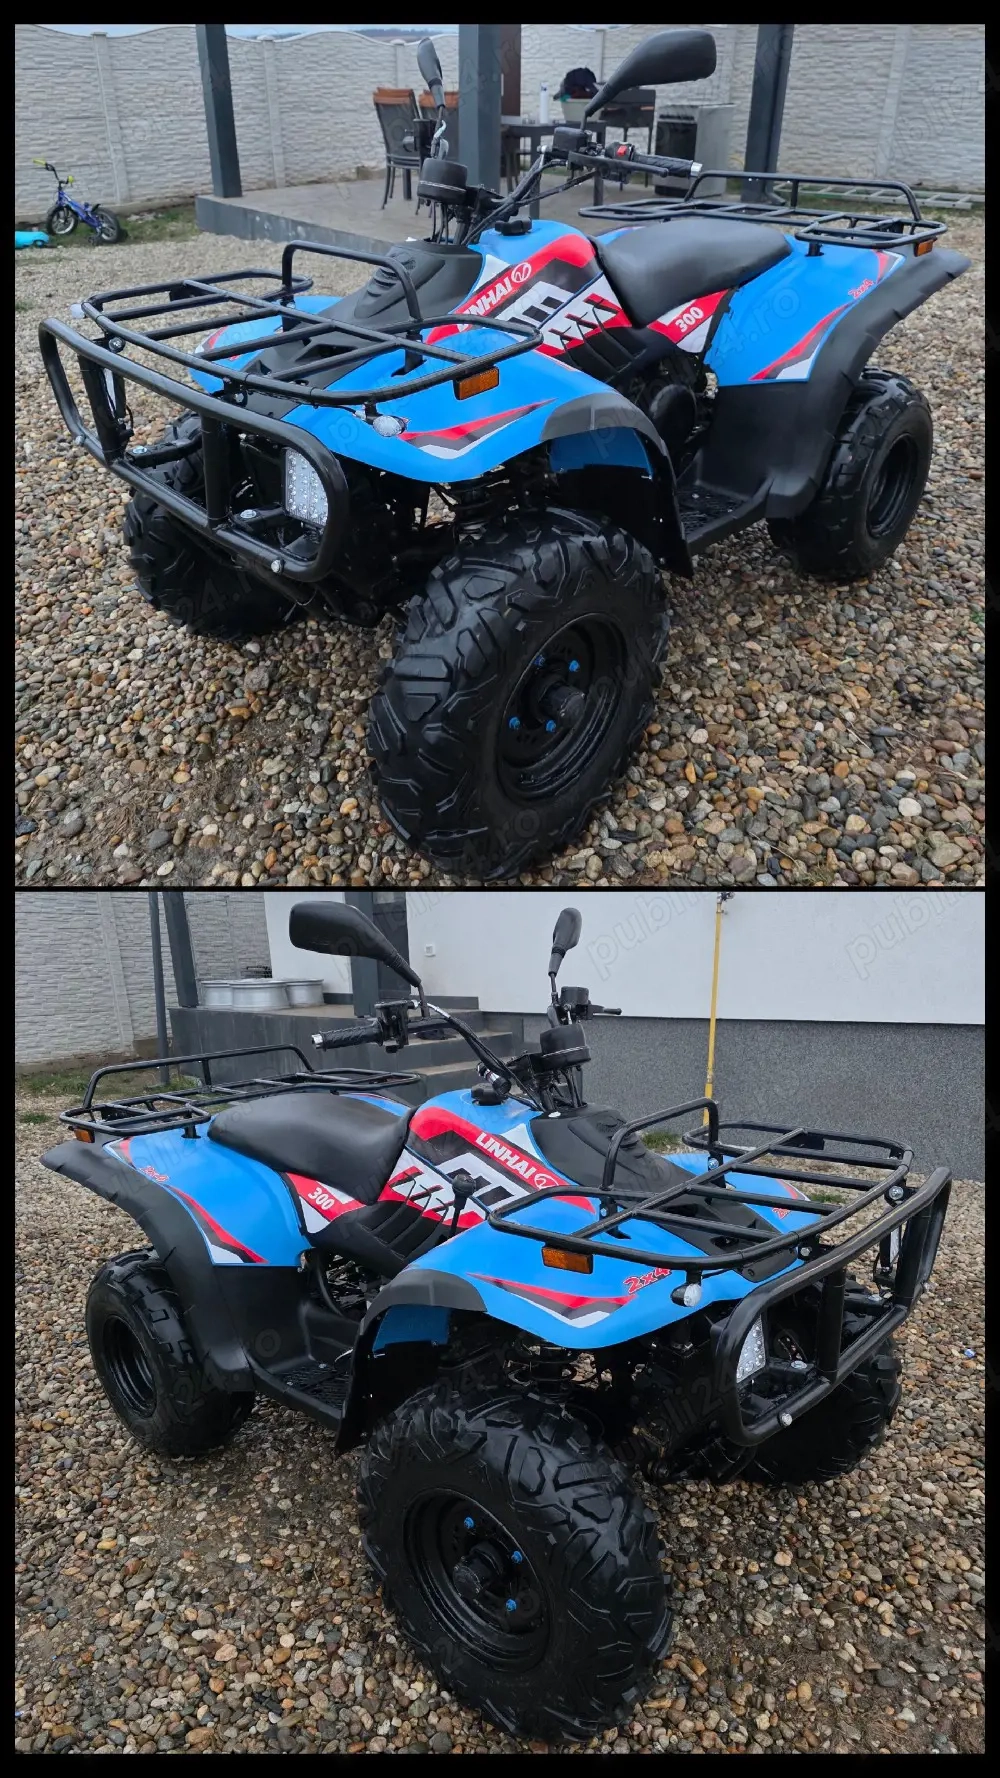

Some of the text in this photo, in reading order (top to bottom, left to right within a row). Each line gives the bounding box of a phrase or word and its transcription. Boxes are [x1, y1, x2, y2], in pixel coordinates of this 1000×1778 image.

[456, 277, 513, 332] NHAI
[675, 307, 704, 333] 300
[475, 1132, 537, 1179] LINHAI
[307, 1187, 335, 1210] 300
